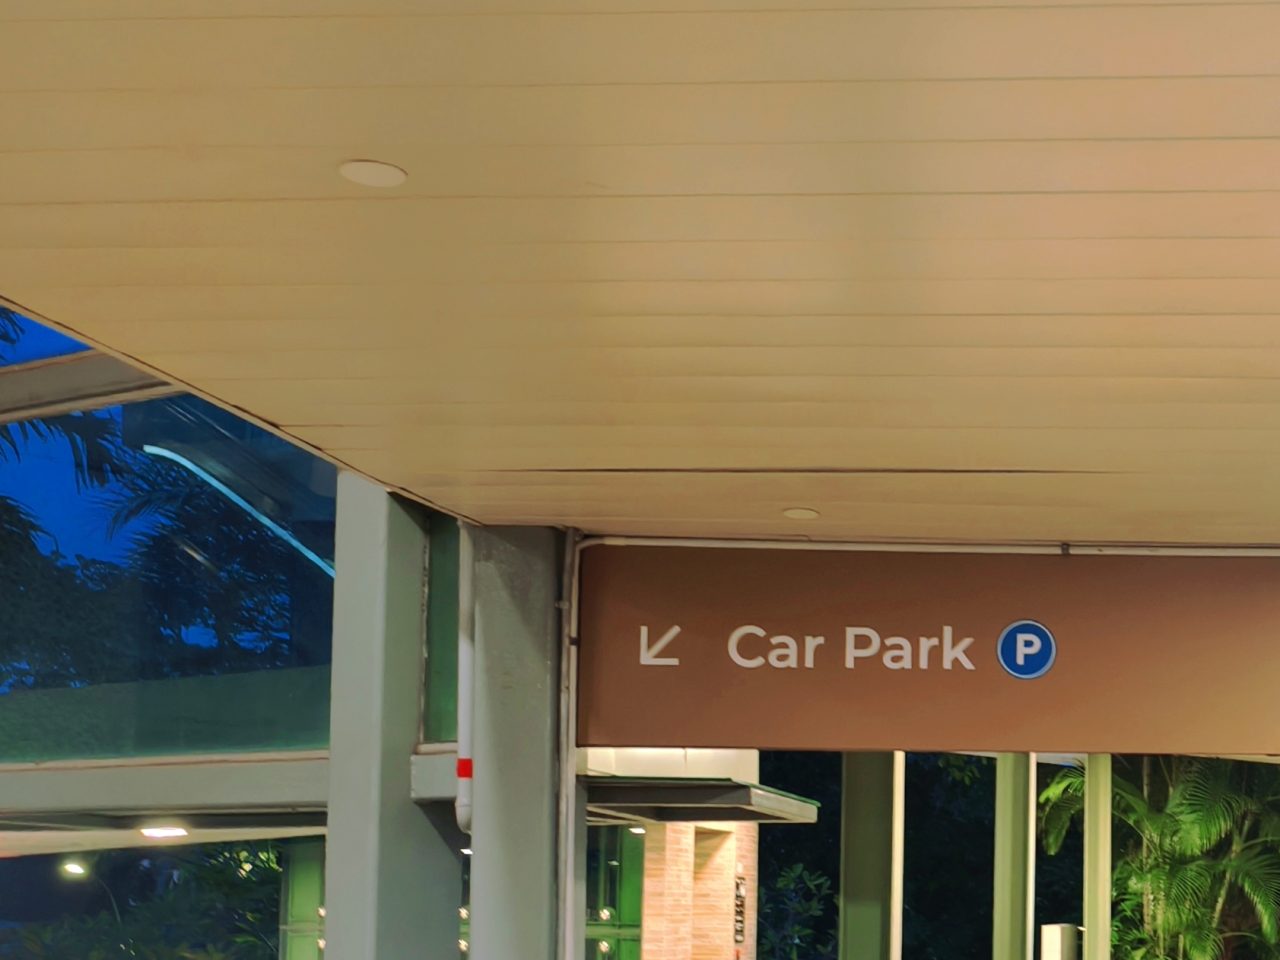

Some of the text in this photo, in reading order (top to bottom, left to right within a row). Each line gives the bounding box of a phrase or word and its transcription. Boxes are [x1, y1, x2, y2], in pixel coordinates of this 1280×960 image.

[727, 625, 1042, 670] Car Park P
